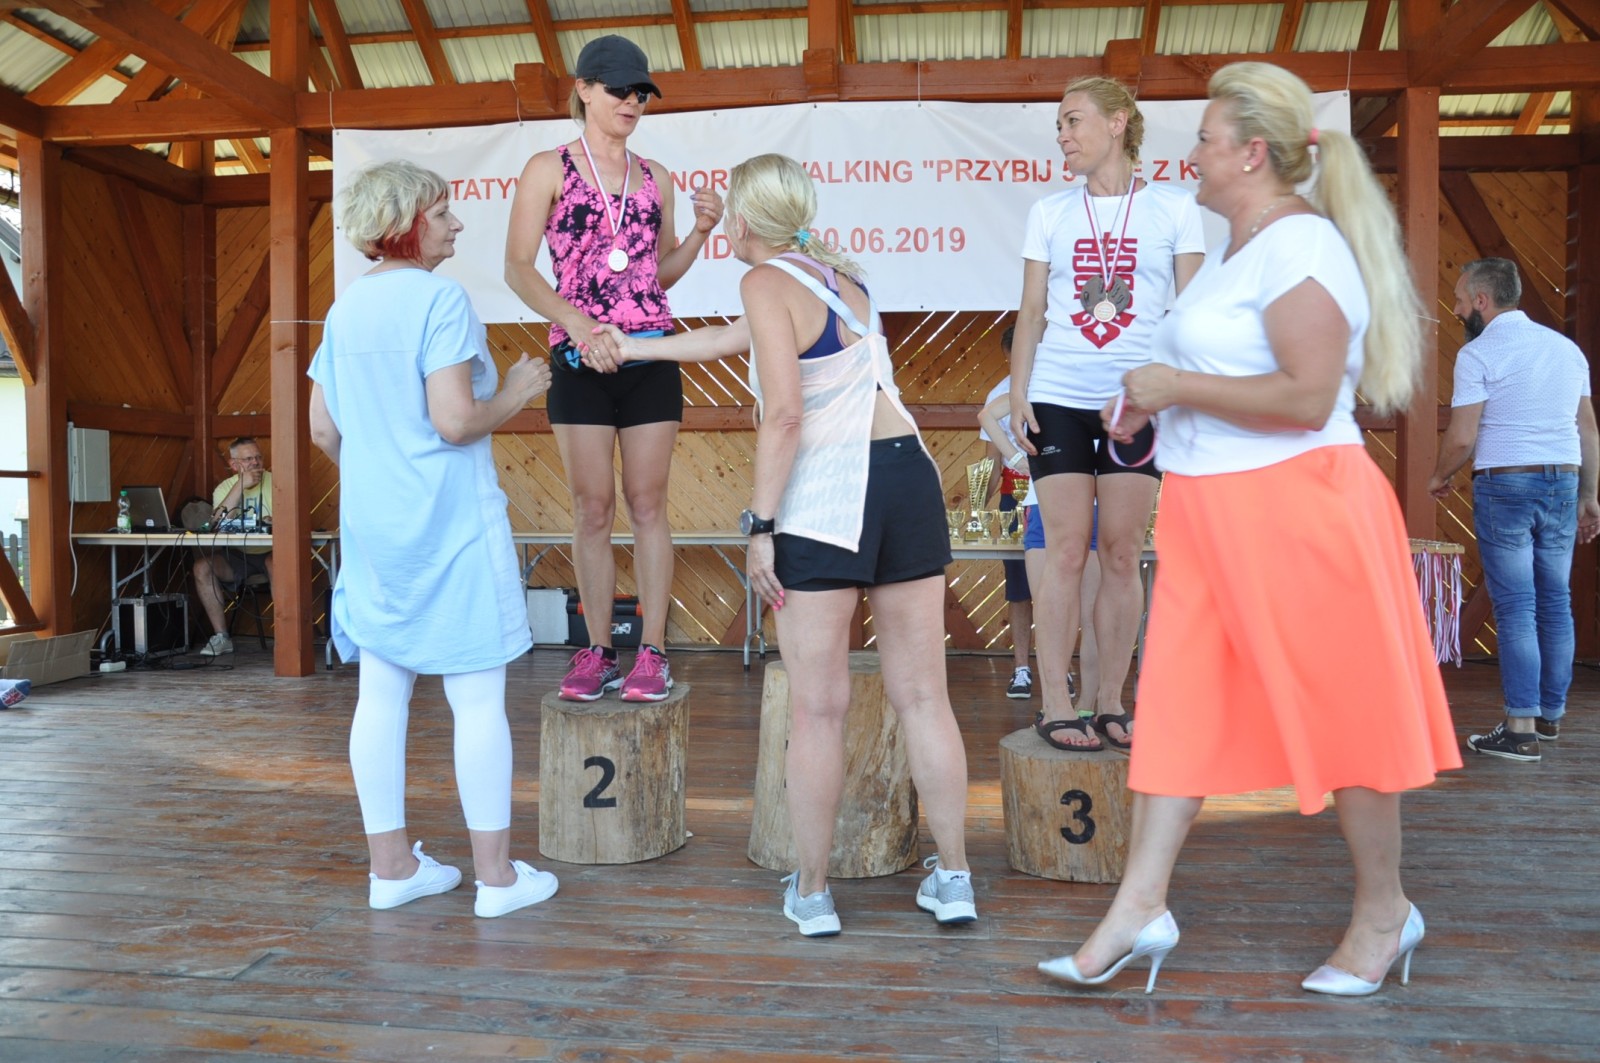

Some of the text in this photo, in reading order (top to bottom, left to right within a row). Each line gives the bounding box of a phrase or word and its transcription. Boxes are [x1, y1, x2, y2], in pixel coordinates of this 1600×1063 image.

[448, 177, 520, 201] TATY
[671, 168, 731, 193] NOR
[803, 160, 913, 184] ALKING
[923, 159, 1052, 183] "PRZYBIJ
[1152, 160, 1170, 181] Z
[1179, 160, 1200, 181] K
[584, 756, 617, 808] 2
[1060, 789, 1096, 844] 3
